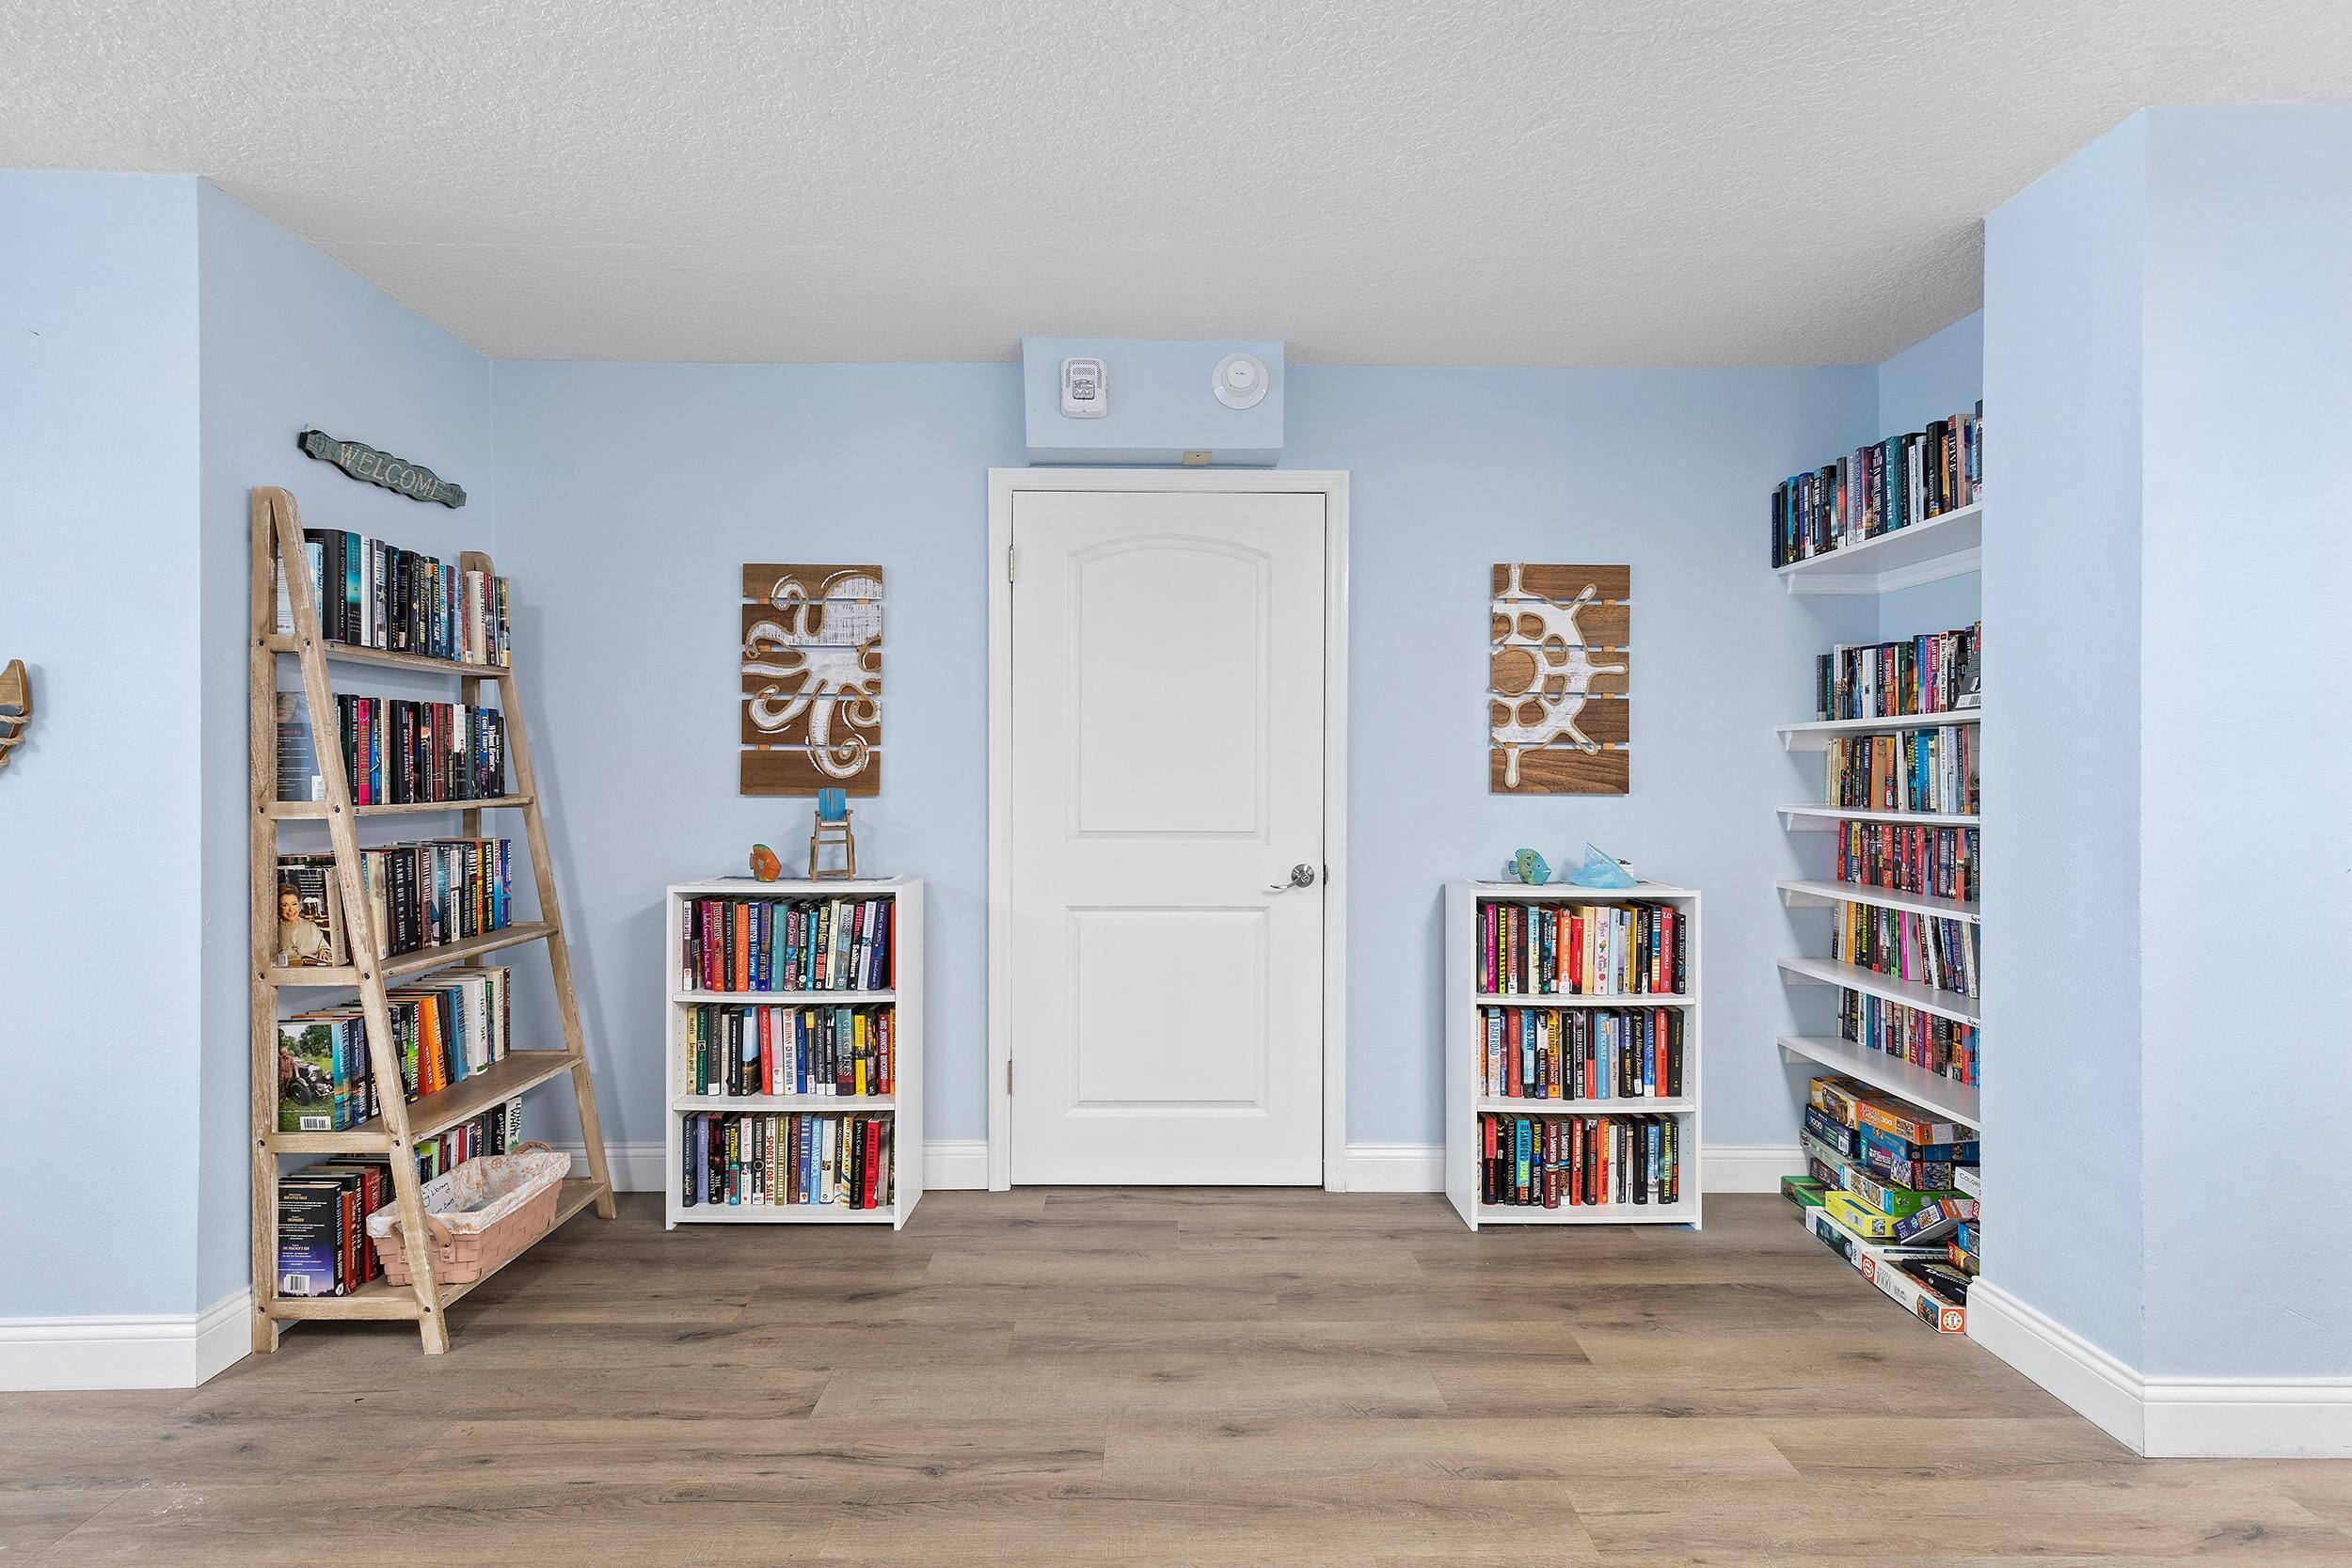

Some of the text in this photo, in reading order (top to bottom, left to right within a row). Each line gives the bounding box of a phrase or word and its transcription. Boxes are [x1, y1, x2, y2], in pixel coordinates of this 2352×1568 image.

[340, 444, 446, 500] WELCOME
[480, 731, 488, 752] Clancy
[488, 748, 497, 772] Remorse
[469, 849, 477, 875] VORTEX
[713, 906, 722, 941] TESS GERRITSEN
[749, 908, 757, 919] TESS
[854, 907, 864, 931] Griffin
[749, 919, 757, 942] GERRITSEN
[817, 953, 826, 964] THE
[455, 989, 466, 1034] JANET DAILEY
[433, 1020, 441, 1045] CRAIS
[842, 1020, 850, 1049] GREG
[1490, 1021, 1499, 1055] BEACH ROAD
[410, 1056, 419, 1090] MIRAGE
[1881, 1116, 1893, 1126] 300
[1519, 1131, 1528, 1161] SANDFORD
[766, 1135, 774, 1201] SPORTS FOR SALE
